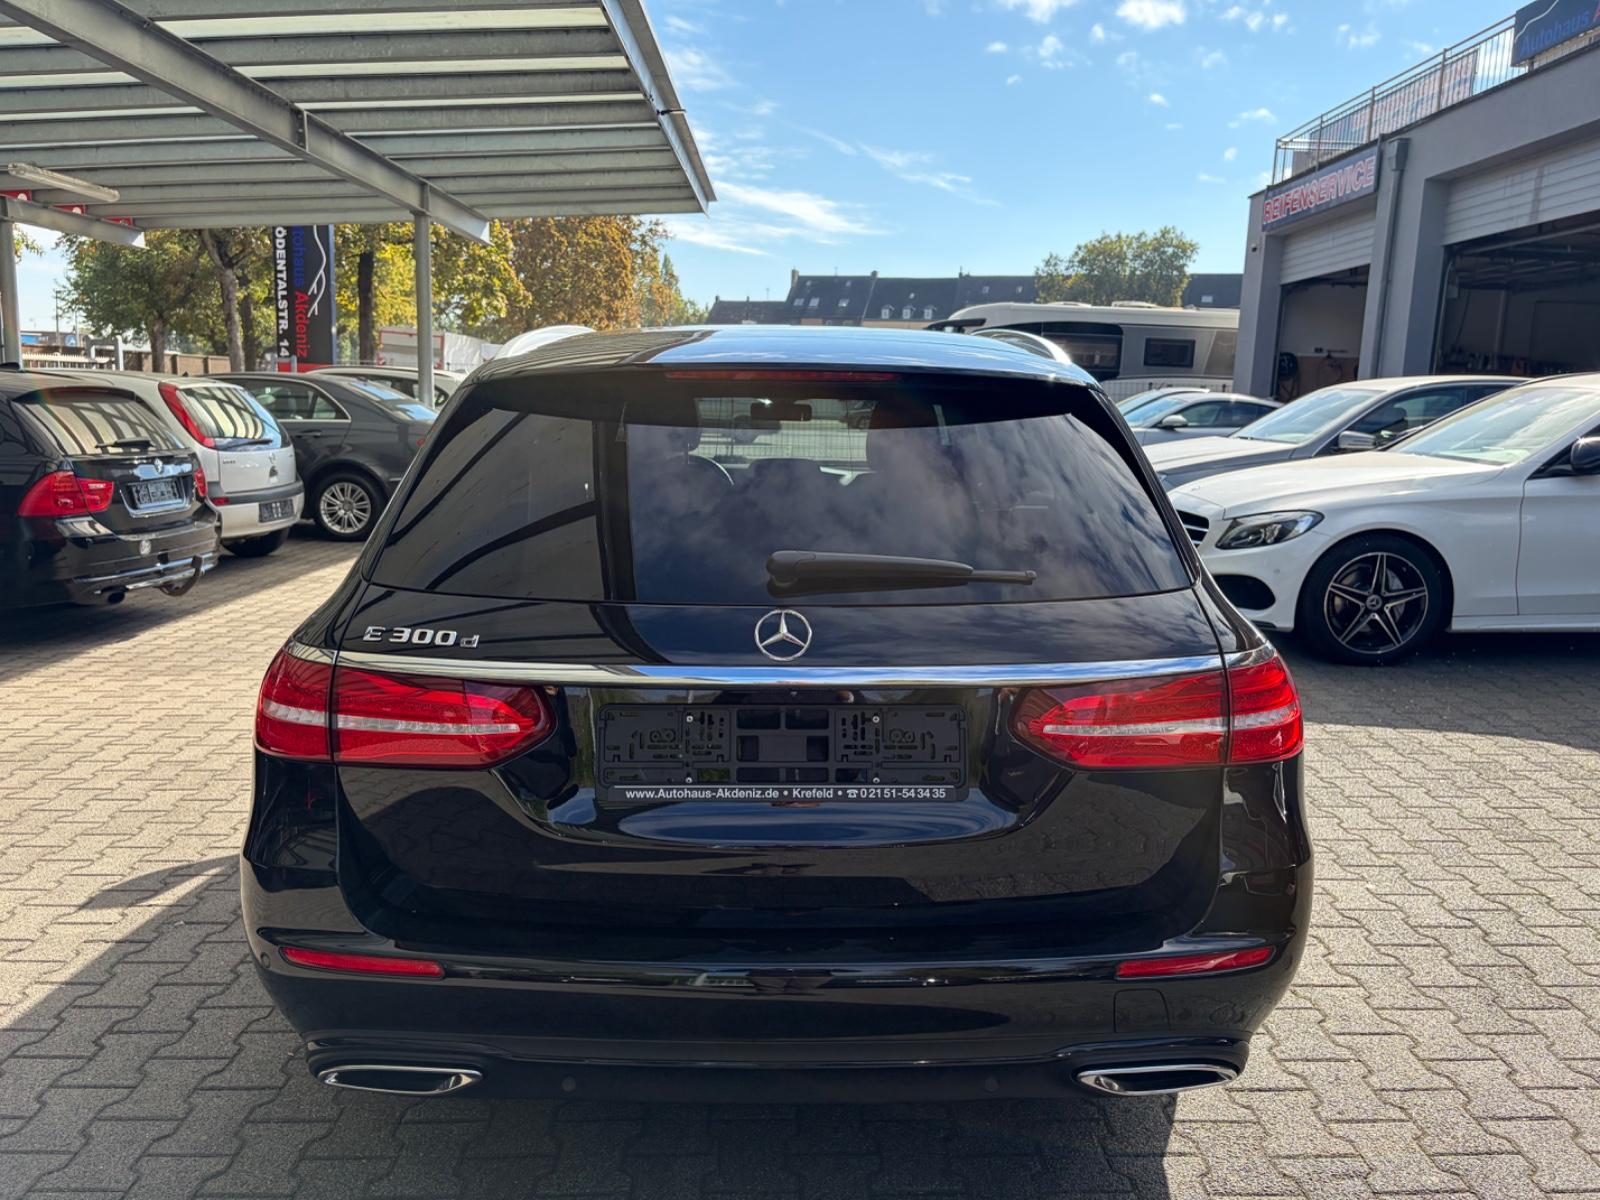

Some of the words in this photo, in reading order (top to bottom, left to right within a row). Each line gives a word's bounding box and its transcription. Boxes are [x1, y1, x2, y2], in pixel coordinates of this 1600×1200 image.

[1519, 9, 1590, 58] Autohaus
[1263, 155, 1377, 225] REIFENSERVICE
[294, 290, 311, 358] Akdeniz
[279, 338, 290, 358] 14
[362, 625, 386, 642] E
[388, 626, 458, 647] 300
[460, 634, 480, 649] d
[625, 788, 780, 799] www.Autohaus-Akdeniz.de
[792, 788, 834, 799] Krefeld
